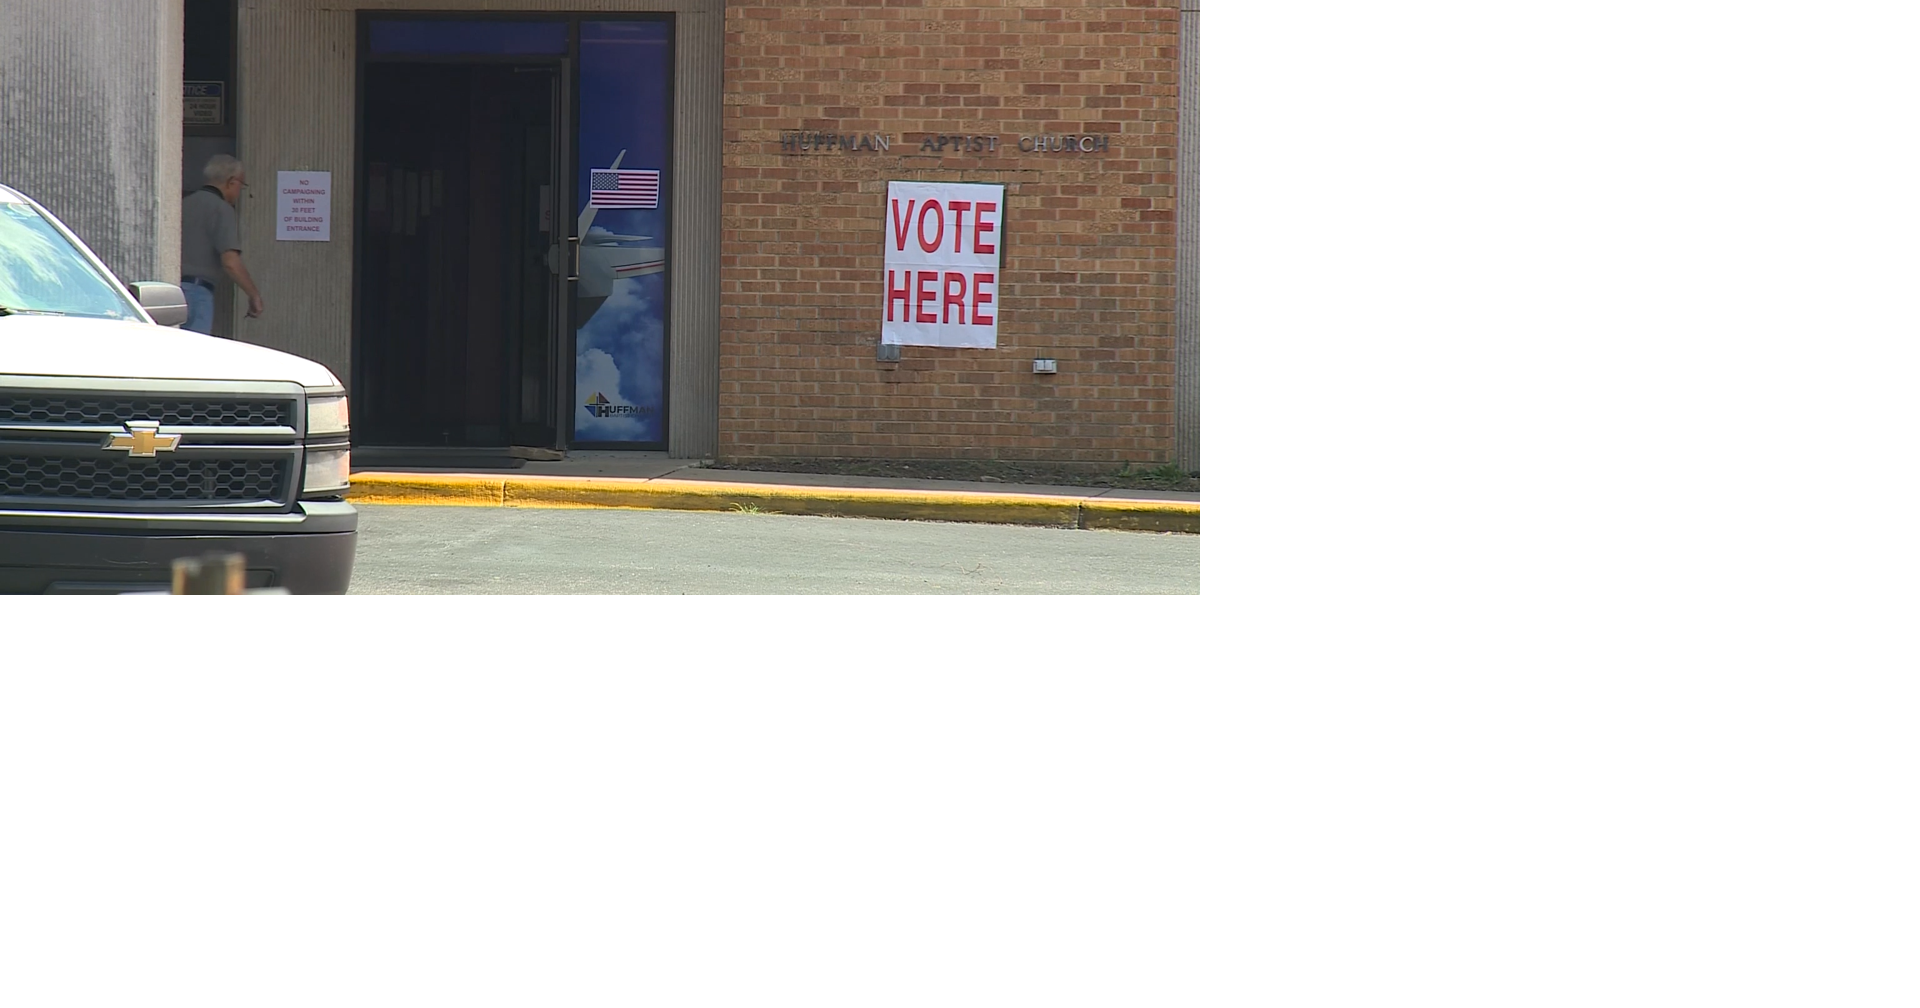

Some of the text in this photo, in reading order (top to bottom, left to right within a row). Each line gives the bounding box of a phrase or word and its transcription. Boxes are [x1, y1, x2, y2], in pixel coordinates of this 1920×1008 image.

[782, 133, 1109, 153] HUFFMAN APTIST CHURCH
[892, 199, 997, 254] VOTE
[887, 270, 995, 326] HERE
[597, 405, 655, 418] HUFFMAN
